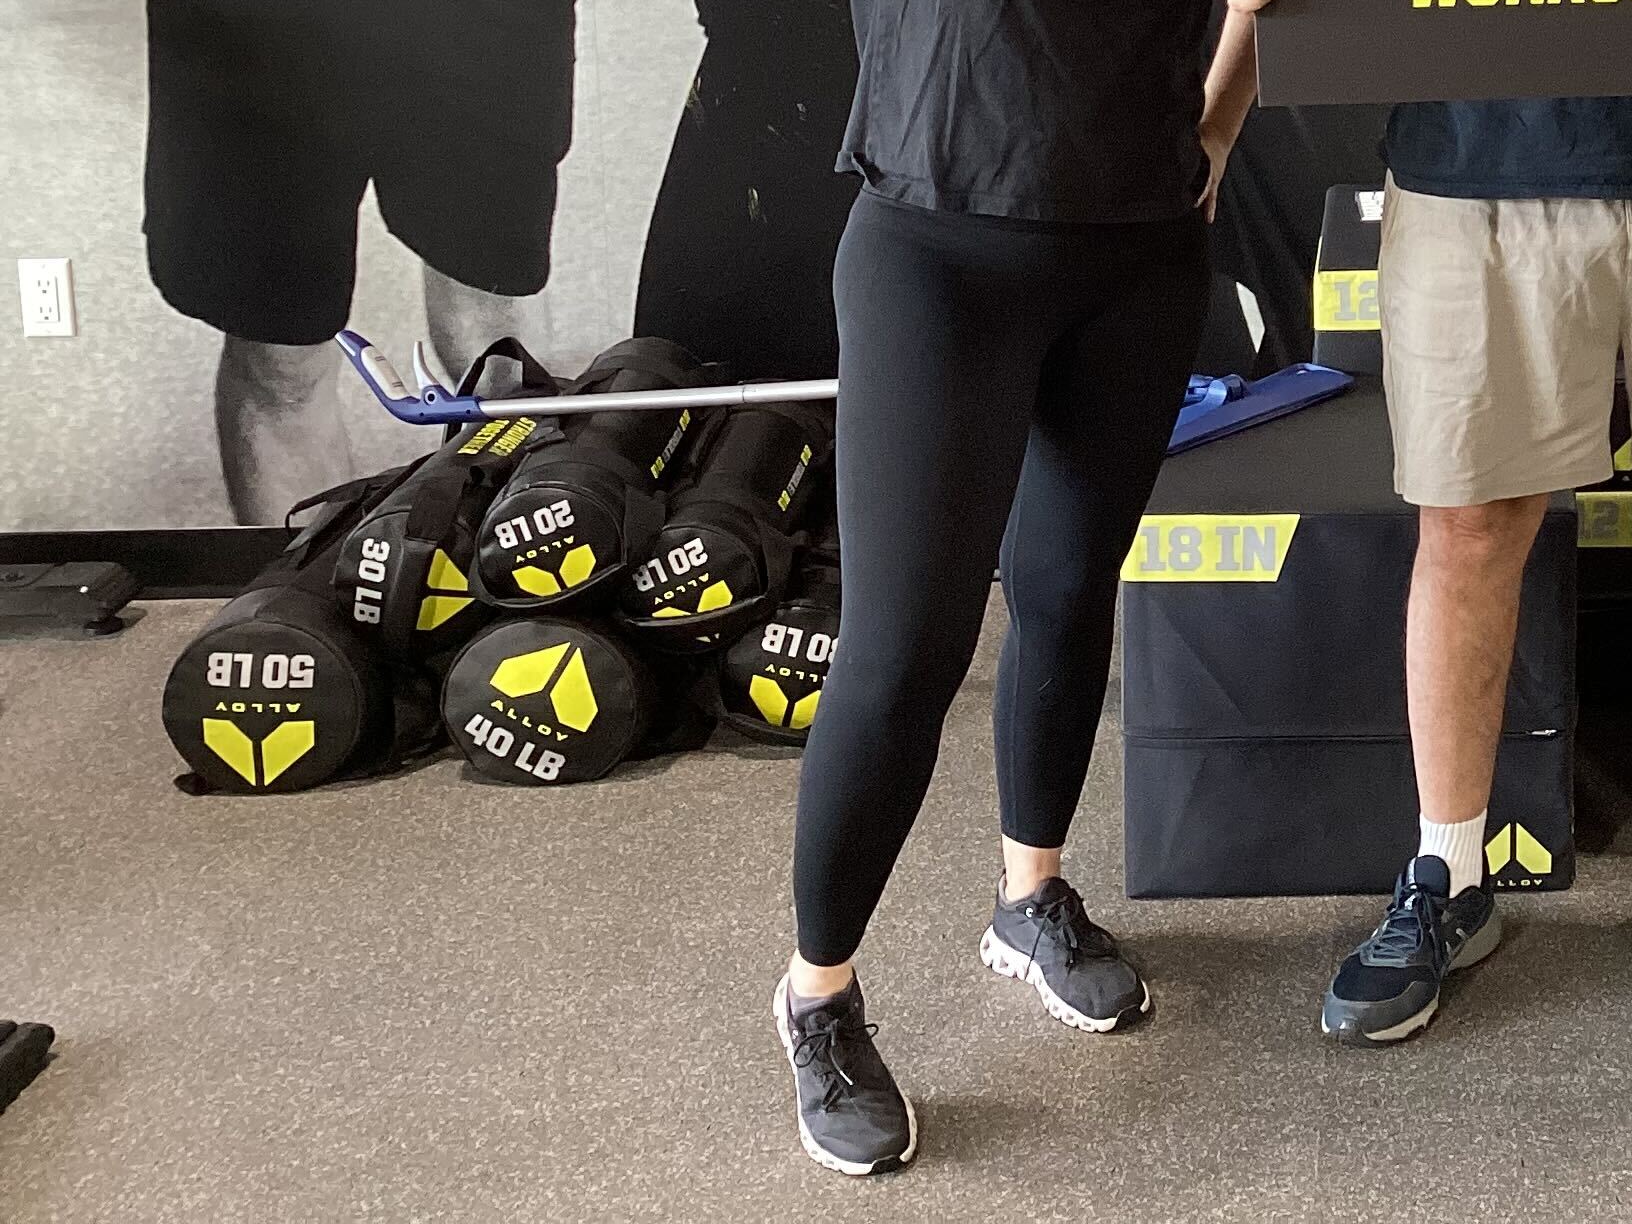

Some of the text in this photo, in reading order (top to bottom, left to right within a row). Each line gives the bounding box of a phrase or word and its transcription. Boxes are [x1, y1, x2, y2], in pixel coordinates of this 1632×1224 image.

[494, 499, 574, 549] 20 LB
[515, 535, 574, 563] ALLOY
[632, 537, 708, 592] 20 LB
[1139, 526, 1276, 572] 18 IN
[353, 538, 390, 625] 30 LB
[654, 572, 709, 605] ALLOY
[761, 623, 803, 659] LB
[207, 652, 315, 689] 50 LB
[765, 663, 826, 683] LLOY
[215, 701, 301, 713] ALLOY
[490, 699, 569, 742] ALLOY
[464, 713, 566, 781] 40 LB
[1496, 879, 1543, 887] LLOY
